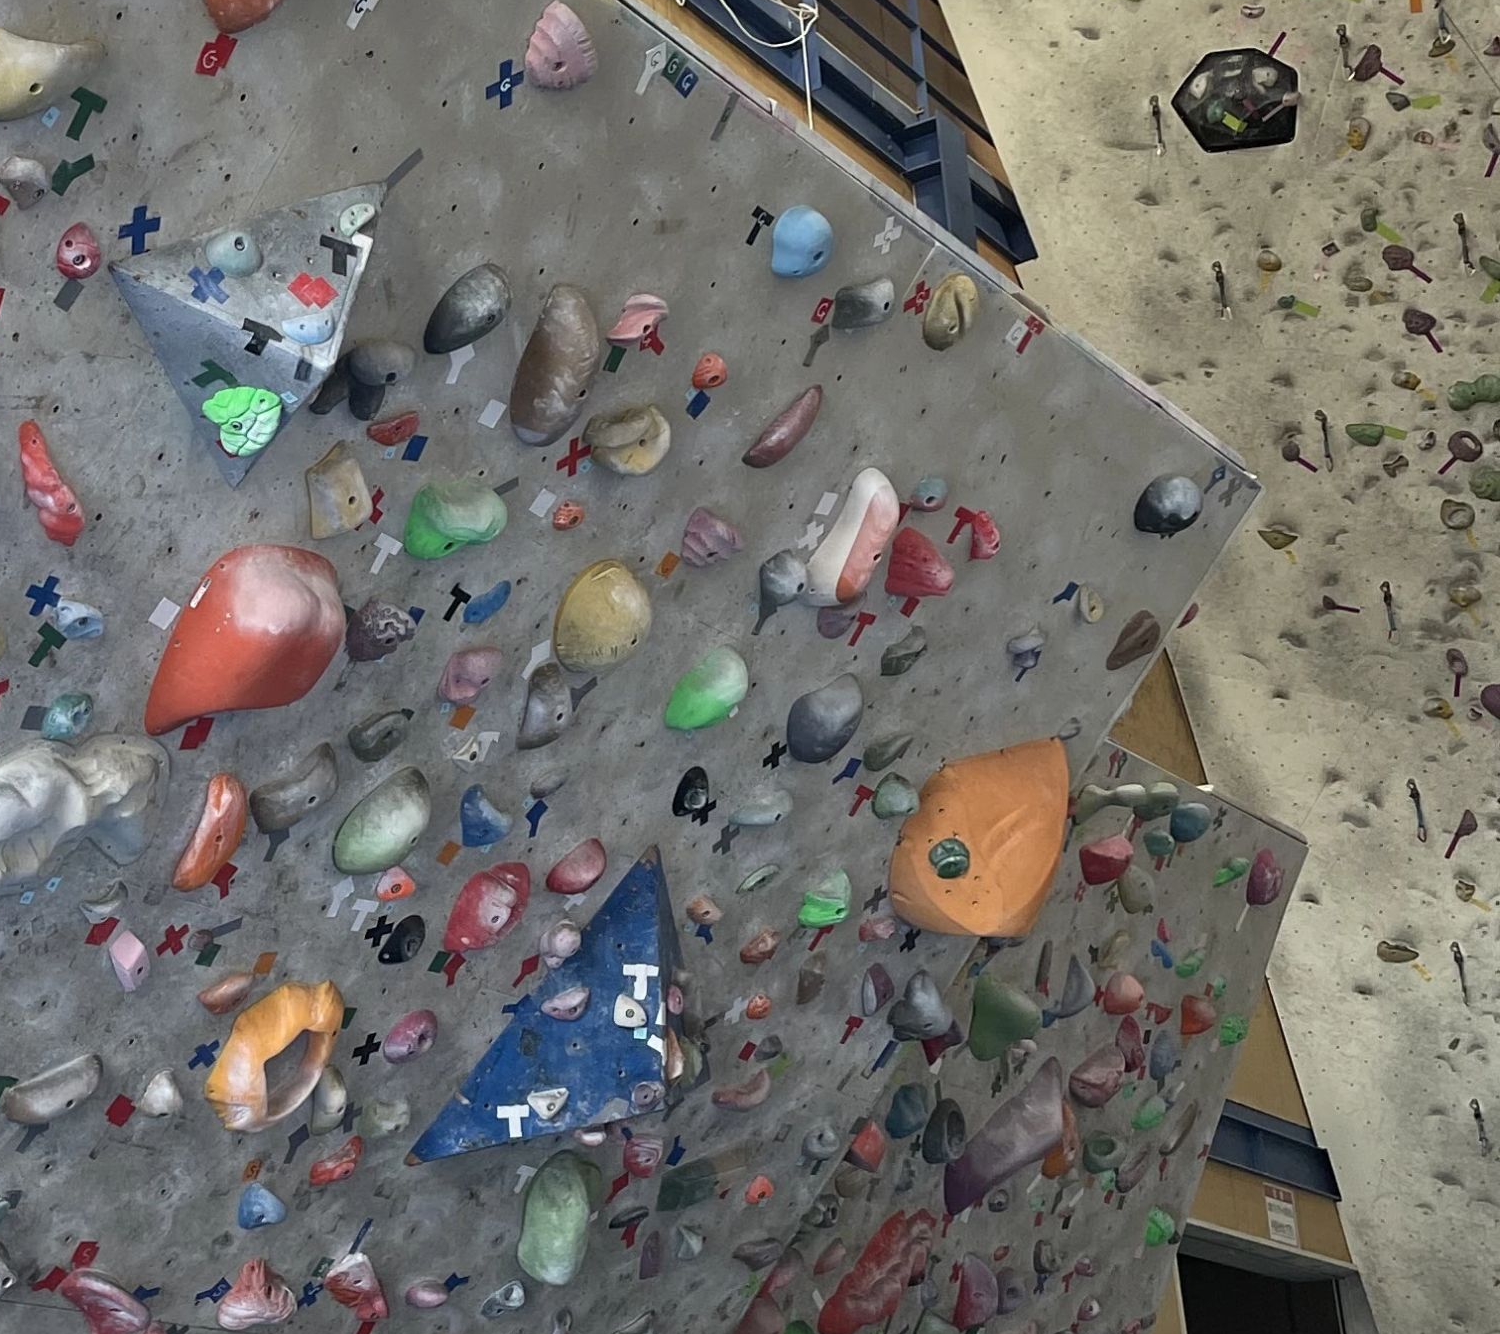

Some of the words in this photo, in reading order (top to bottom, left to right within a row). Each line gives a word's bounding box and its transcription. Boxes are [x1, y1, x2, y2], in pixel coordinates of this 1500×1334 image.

[202, 49, 218, 70] G
[650, 50, 662, 68] G
[667, 57, 679, 74] G
[499, 78, 511, 93] G
[817, 301, 830, 318] G
